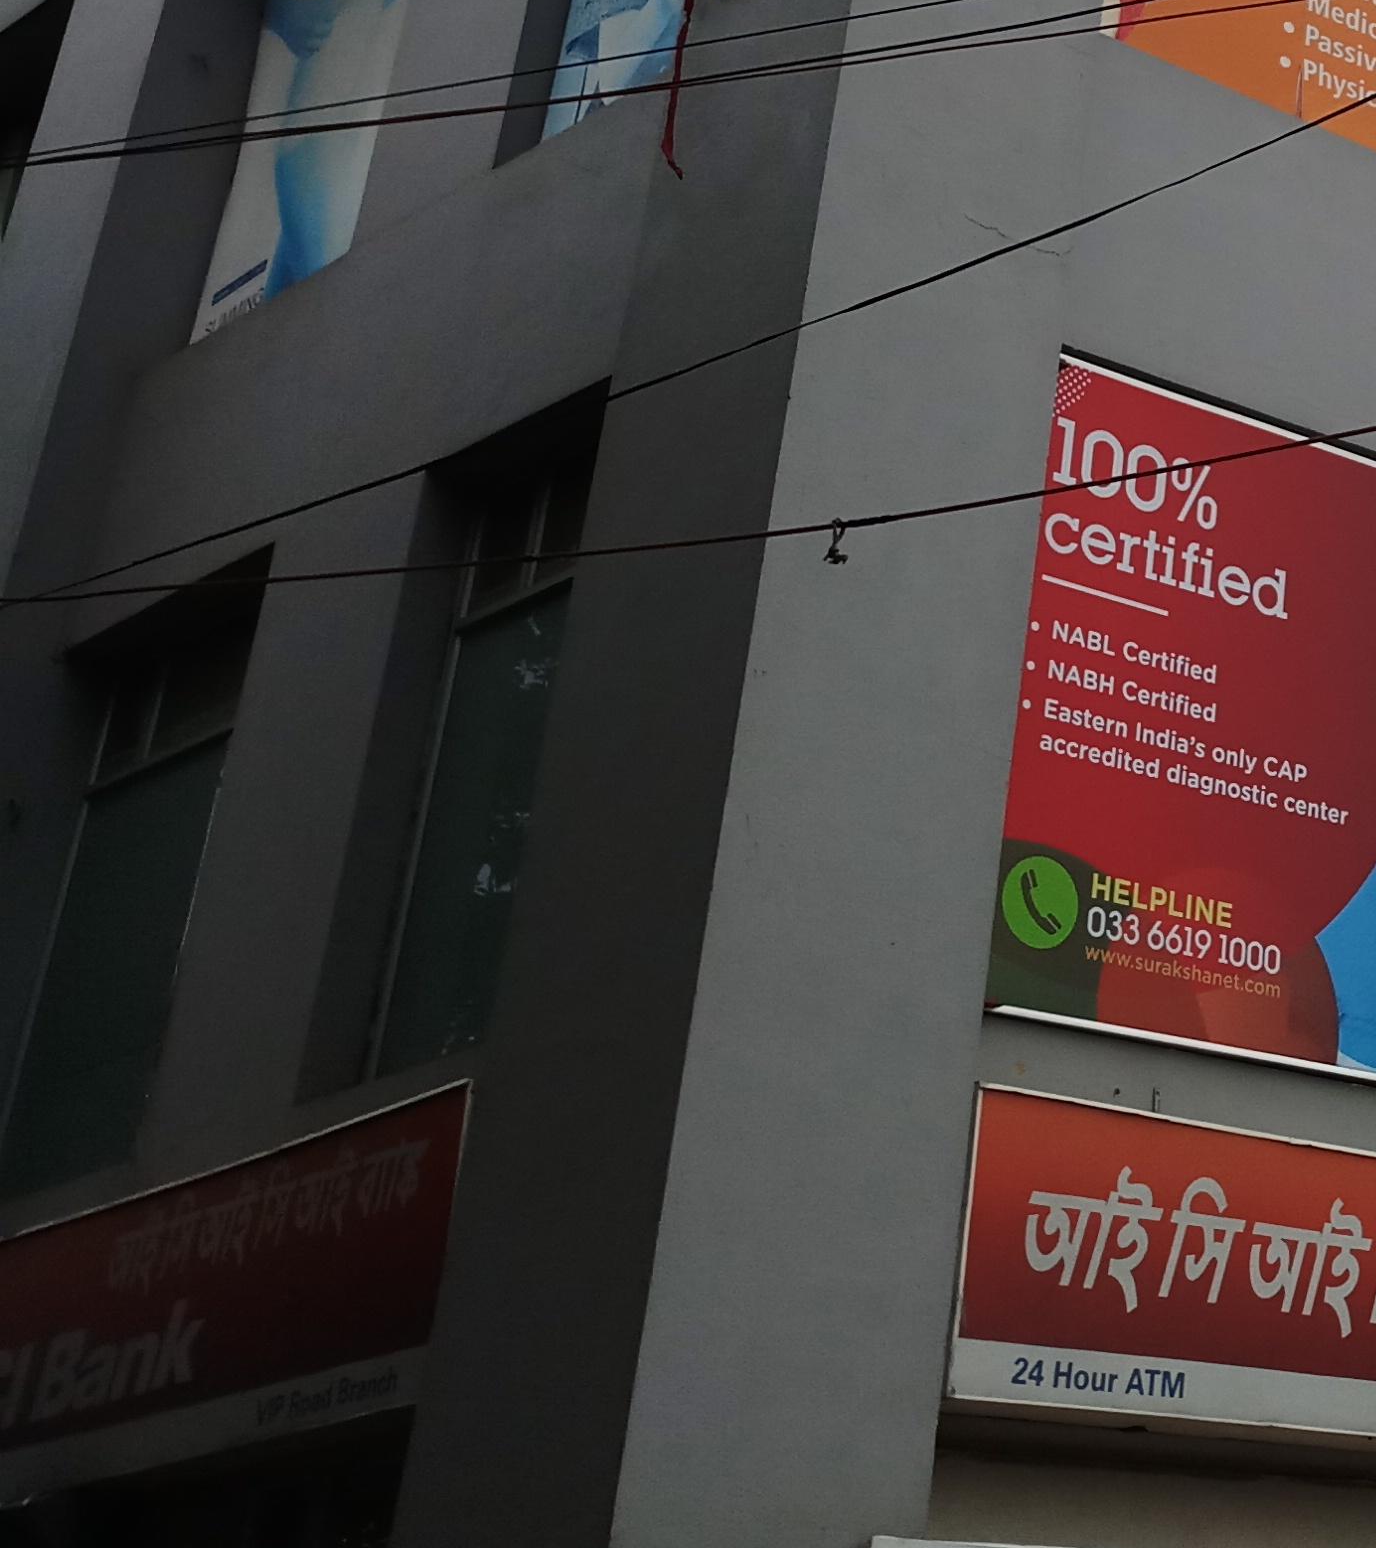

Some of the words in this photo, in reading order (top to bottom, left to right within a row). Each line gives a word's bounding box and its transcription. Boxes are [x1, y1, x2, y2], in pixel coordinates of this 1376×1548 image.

[1051, 416, 1218, 531] 100%
[1044, 511, 1289, 620] certified
[1051, 619, 1116, 657] NABL
[1121, 639, 1218, 685] Certified
[1047, 659, 1116, 697] NABH
[1121, 680, 1217, 723] Certified
[1043, 698, 1128, 739] Eastern
[1134, 721, 1206, 760] India's
[1212, 741, 1258, 783] only
[1262, 755, 1307, 783] CAP
[1040, 729, 1161, 782] accredited
[1167, 759, 1278, 811] diagnostic
[1283, 792, 1349, 826] center
[1091, 873, 1233, 928] HELPLINE
[1084, 942, 1282, 998] www.surakshanet.com
[1086, 906, 1141, 945] 033
[1147, 915, 1212, 961] 6619
[1218, 932, 1282, 976] 1000
[1024, 1165, 1165, 1313] আই
[1156, 1176, 1246, 1305] সি
[1249, 1197, 1372, 1339] আই
[1010, 1357, 1046, 1388] 24
[1052, 1362, 1119, 1394] Hour
[1125, 1367, 1187, 1401] ATM
